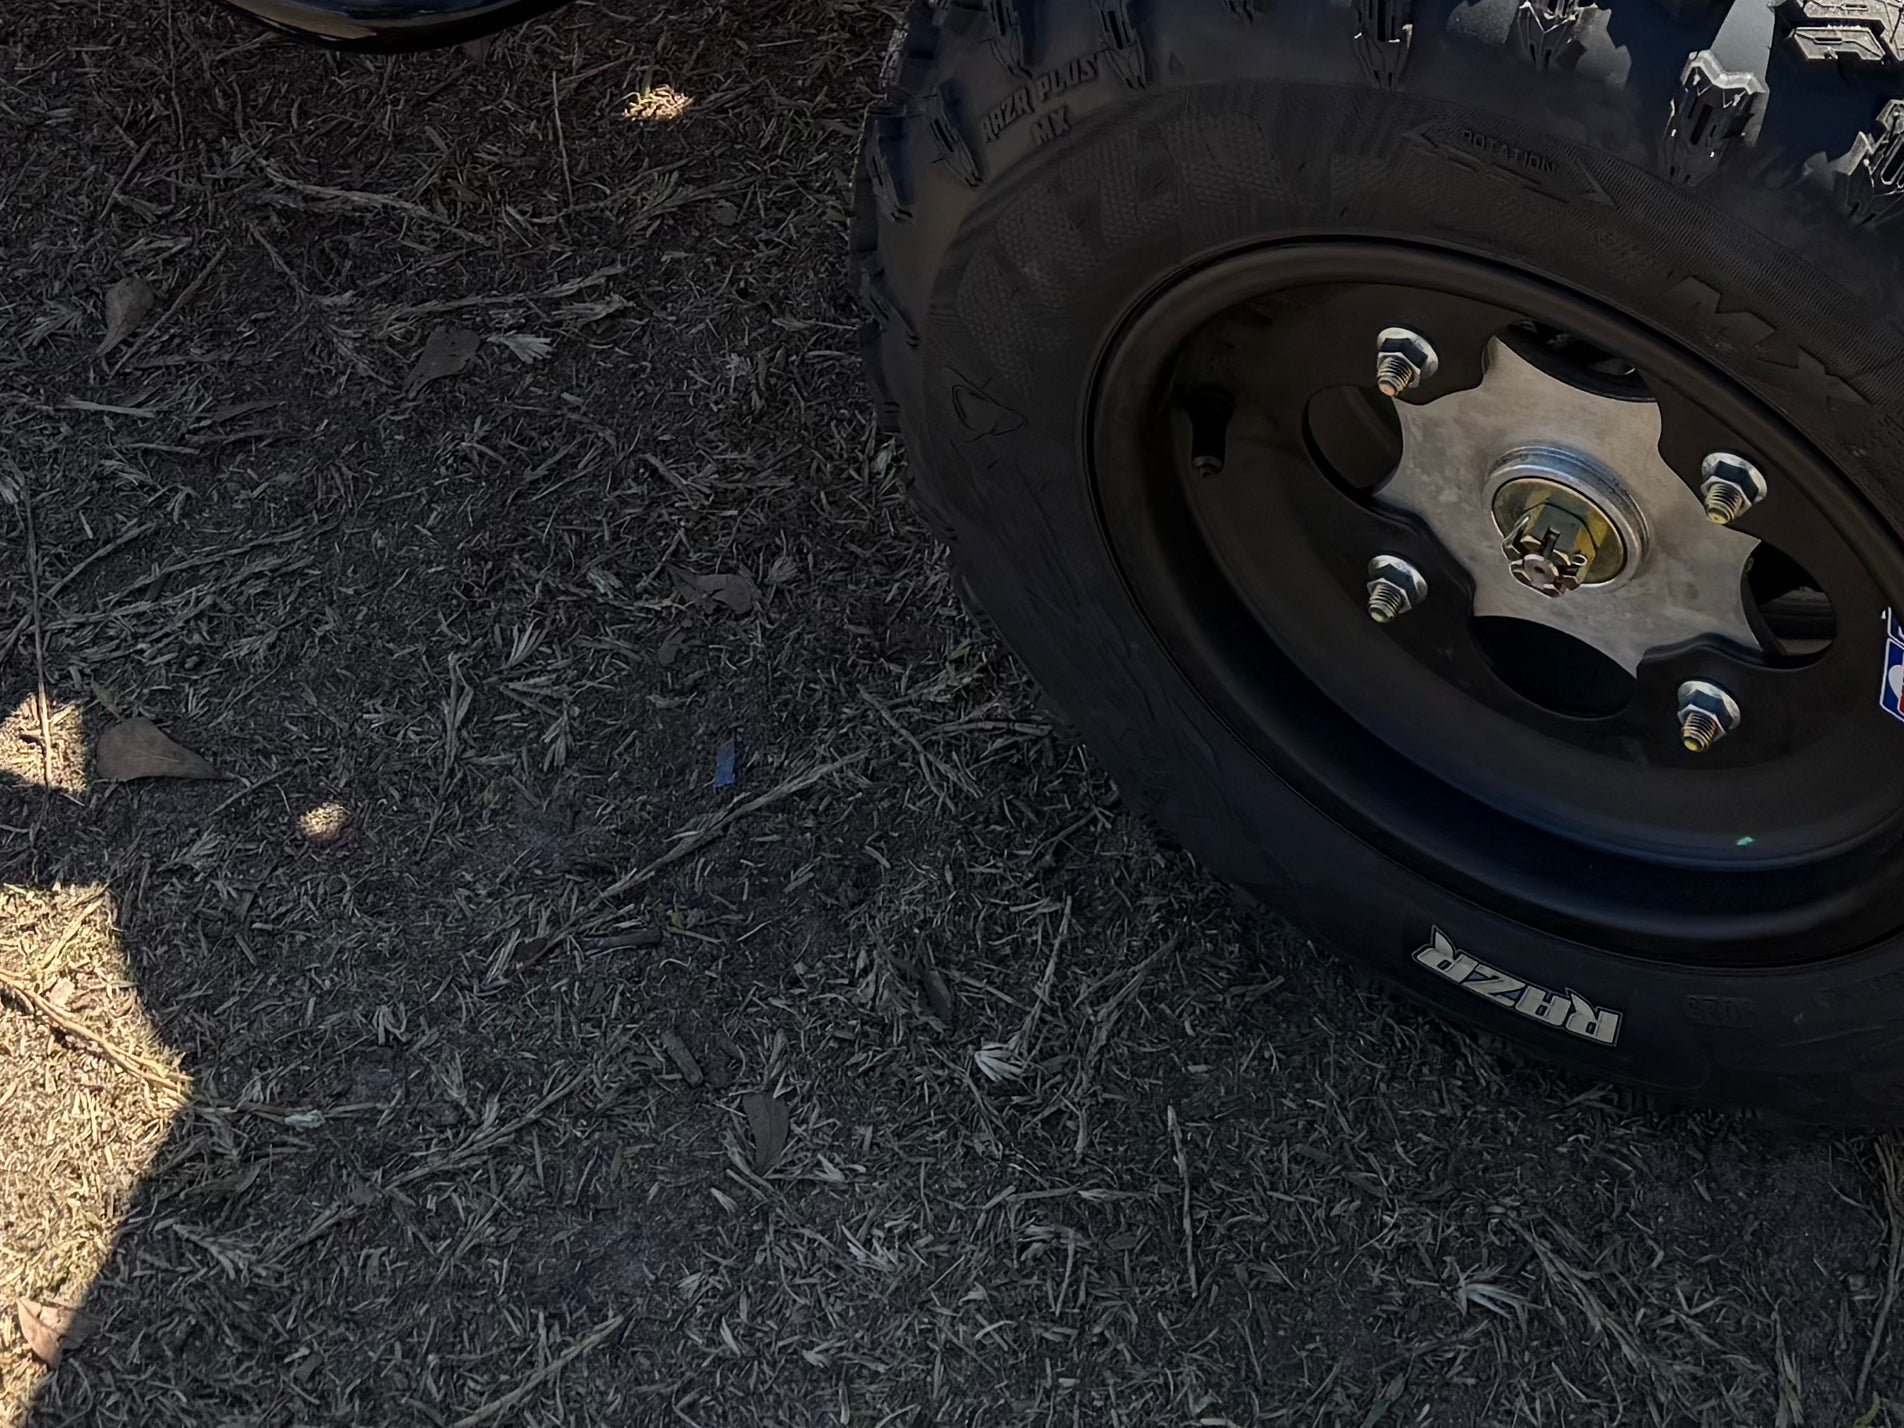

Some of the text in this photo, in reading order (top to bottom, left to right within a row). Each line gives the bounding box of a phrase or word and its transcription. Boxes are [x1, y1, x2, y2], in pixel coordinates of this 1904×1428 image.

[979, 52, 1100, 144] RAZR PLUS
[1029, 104, 1072, 145] MX
[1460, 127, 1558, 176] ROTATION
[1411, 925, 1621, 1046] RAZR
